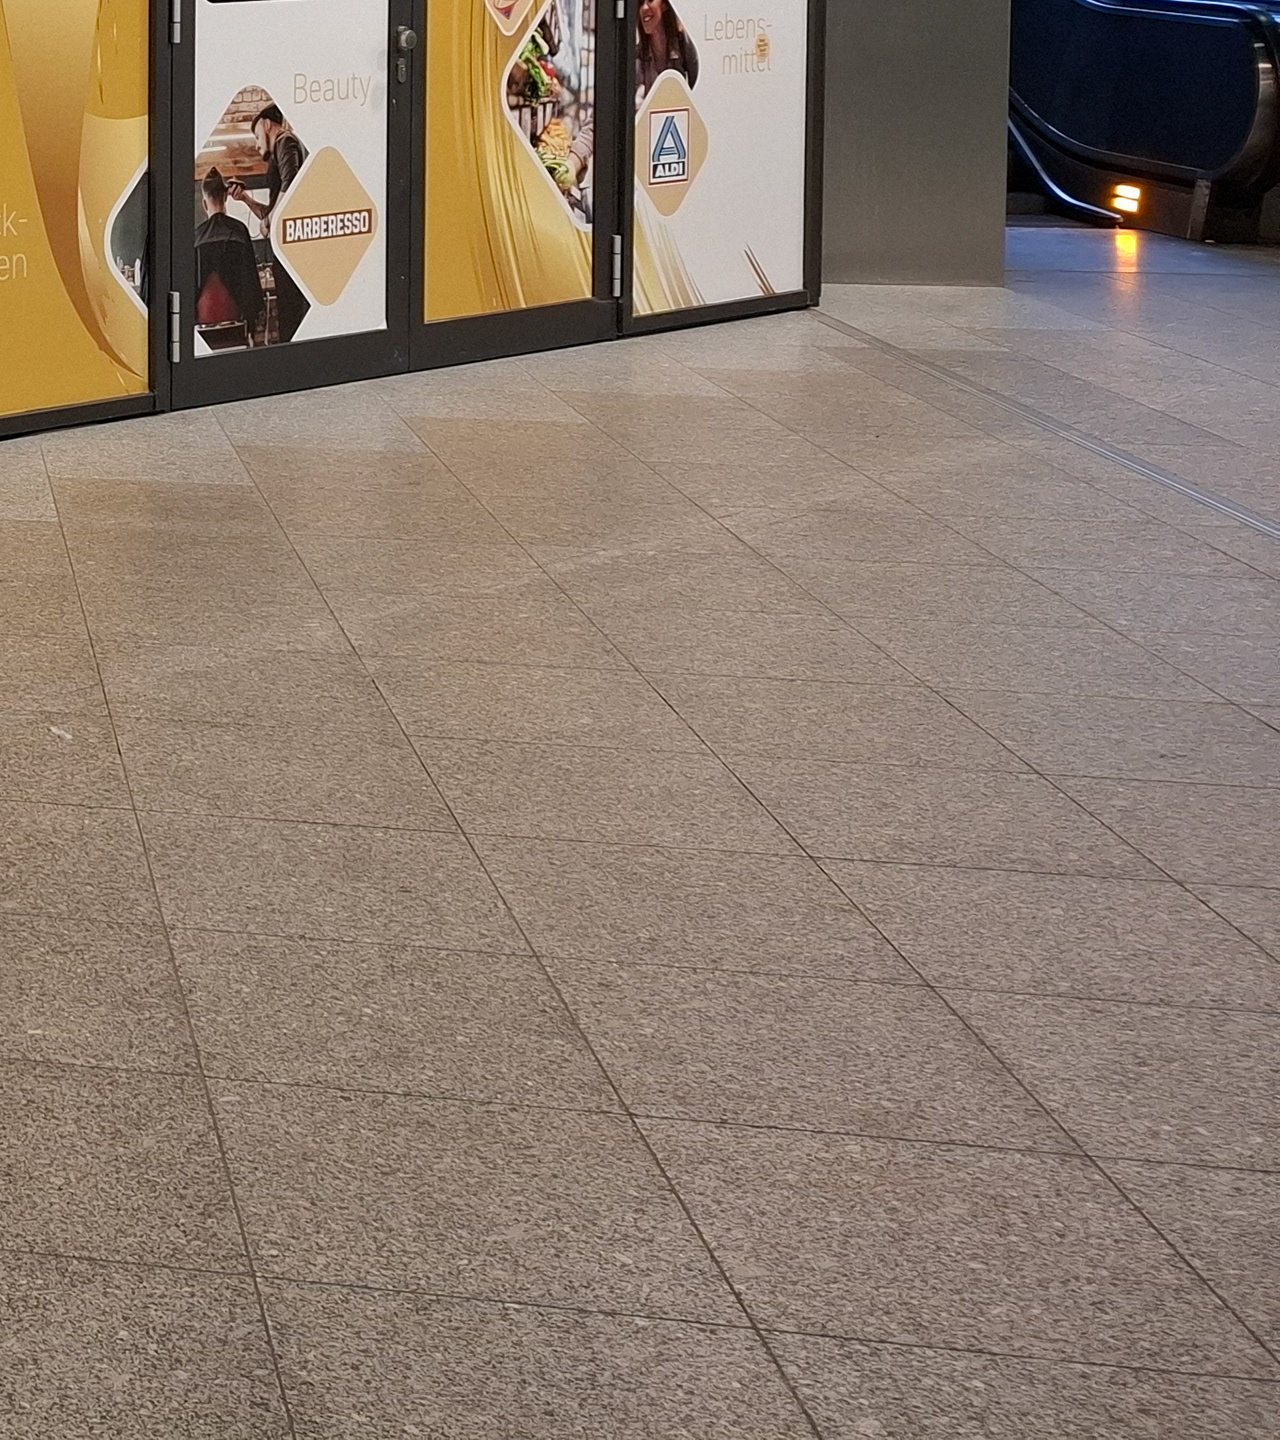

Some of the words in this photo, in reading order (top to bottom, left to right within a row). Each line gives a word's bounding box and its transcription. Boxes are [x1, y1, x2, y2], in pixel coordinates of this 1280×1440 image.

[704, 13, 773, 42] Lebens-
[293, 72, 372, 107] Beauty
[655, 162, 683, 178] ALDI
[285, 211, 370, 243] BARBERESSO
